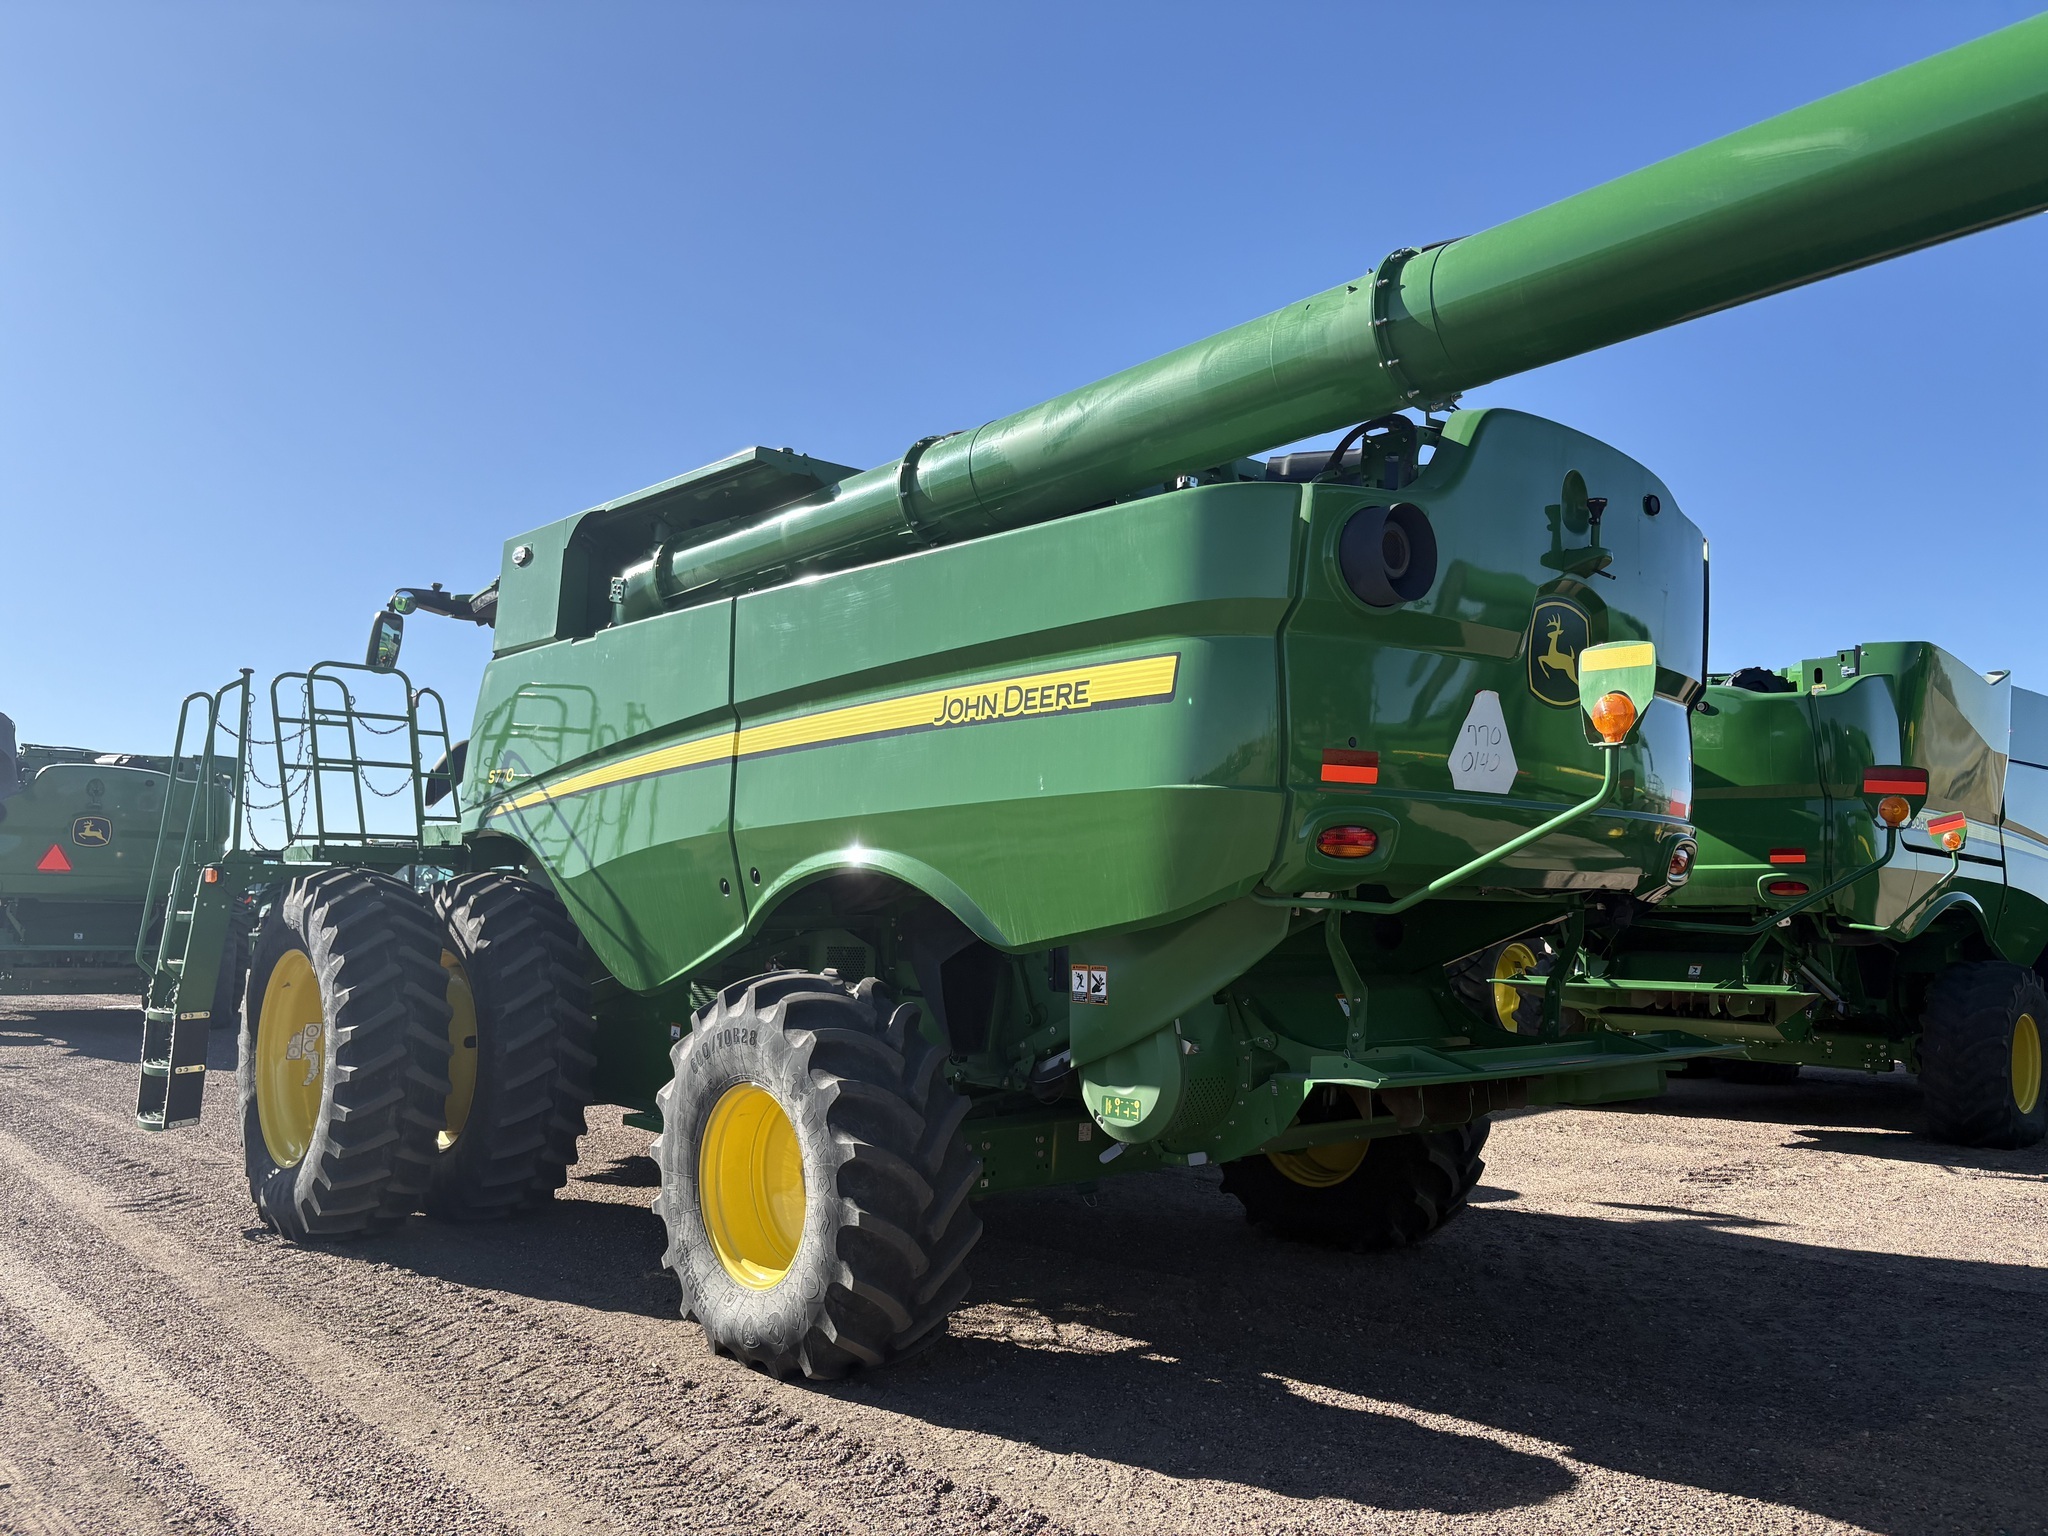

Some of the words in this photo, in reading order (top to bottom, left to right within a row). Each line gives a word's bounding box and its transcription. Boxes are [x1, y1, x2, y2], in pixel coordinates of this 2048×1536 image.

[934, 693, 998, 722] JOHN
[1004, 680, 1091, 714] DEERE
[1467, 724, 1502, 747] 770
[488, 767, 515, 784] S770
